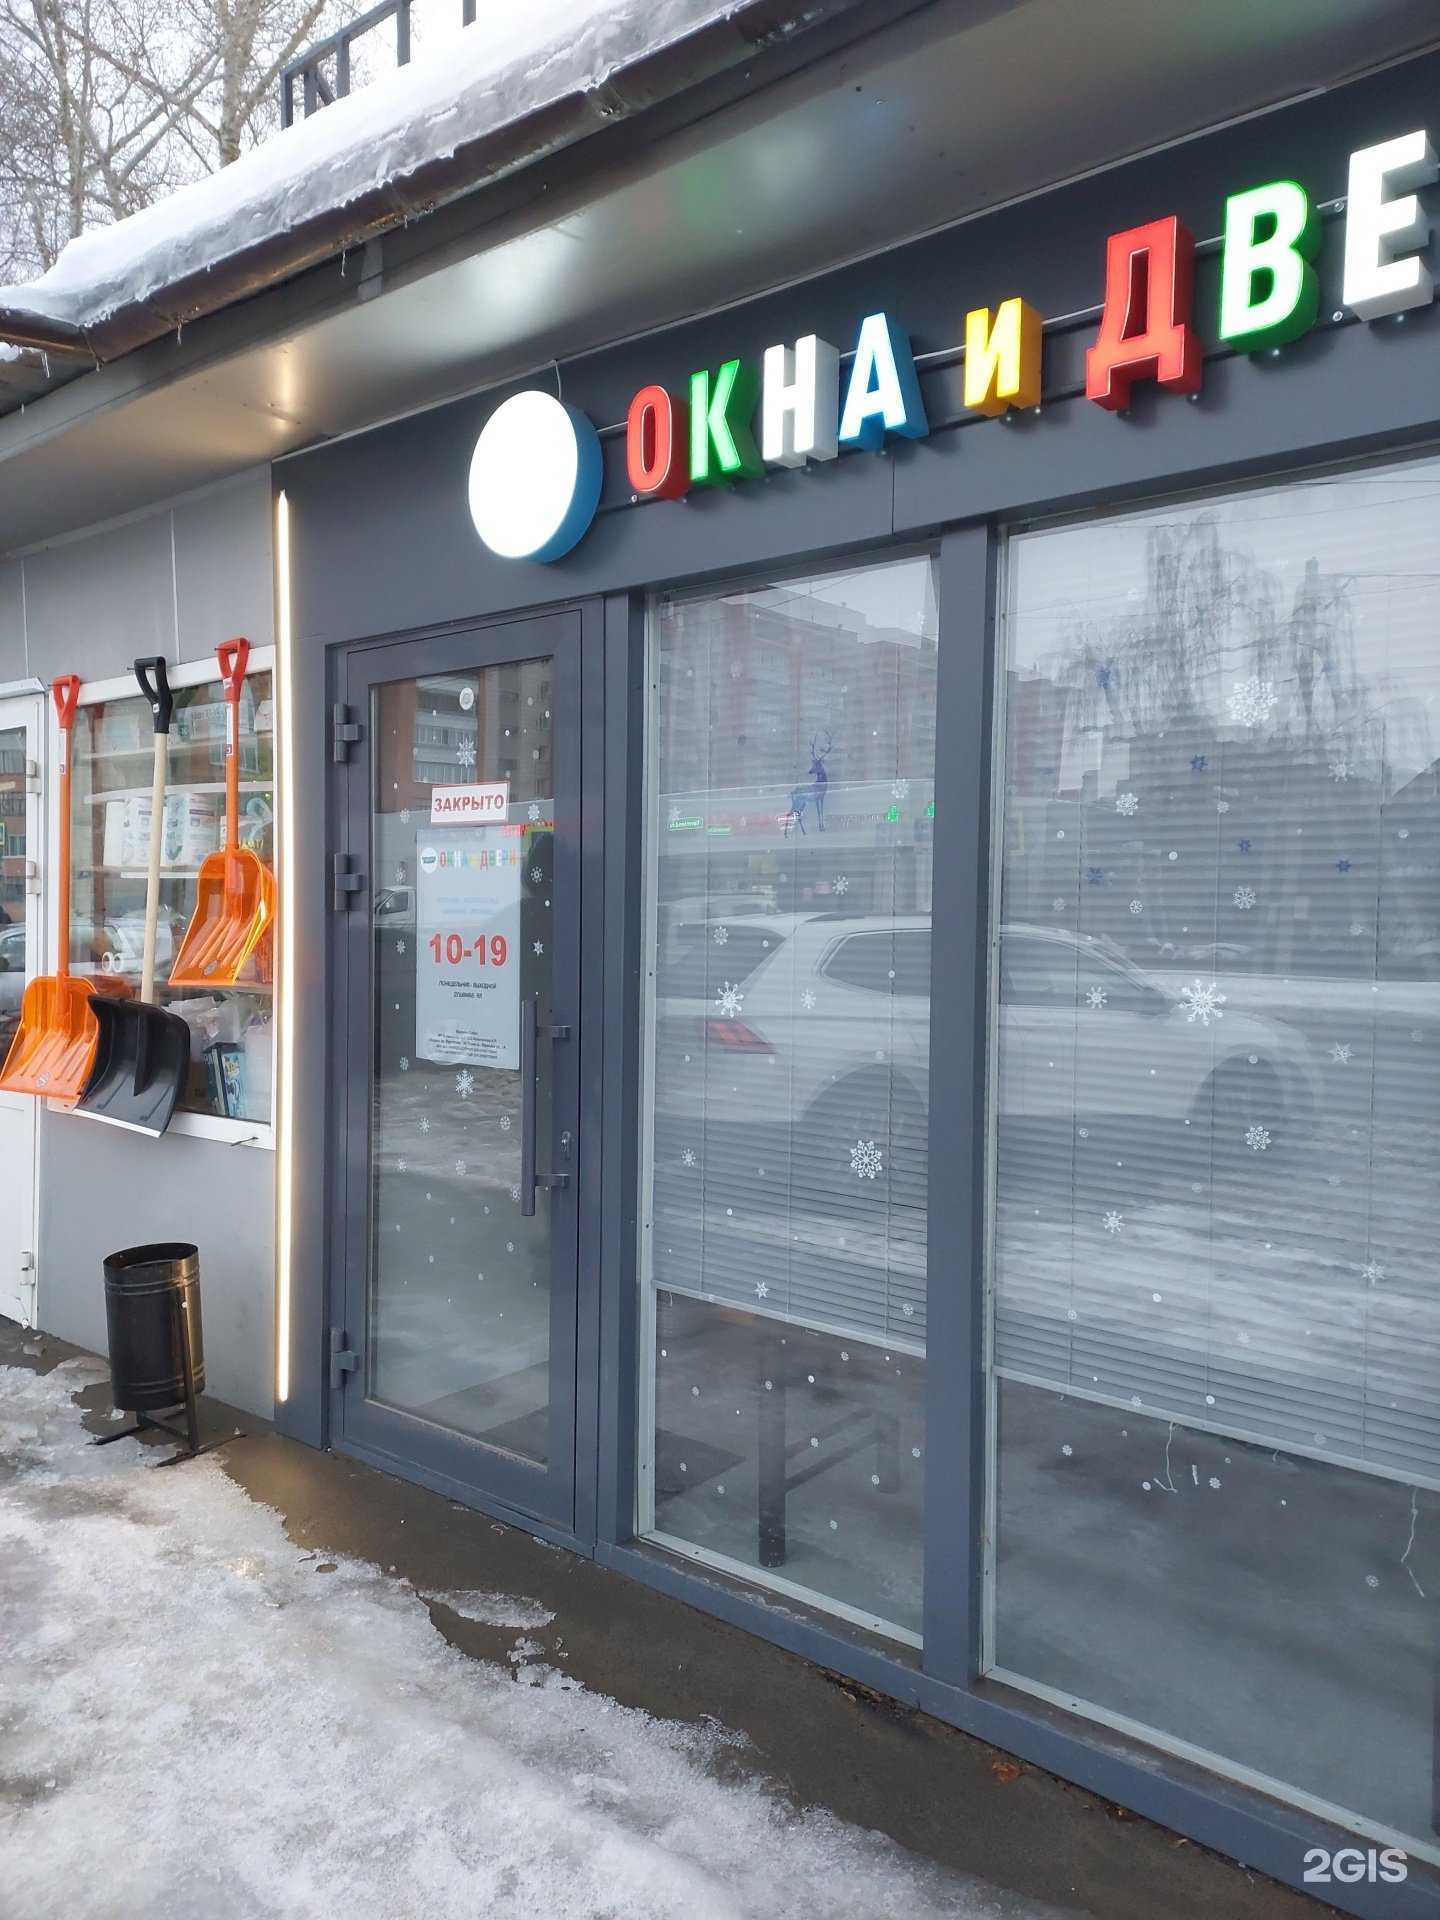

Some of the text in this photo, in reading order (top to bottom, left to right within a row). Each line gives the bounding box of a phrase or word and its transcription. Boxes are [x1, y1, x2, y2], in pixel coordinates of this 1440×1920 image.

[626, 312, 913, 493] ОКНА
[434, 794, 504, 813] ЗАКРЫТО
[430, 933, 507, 967] 10-19
